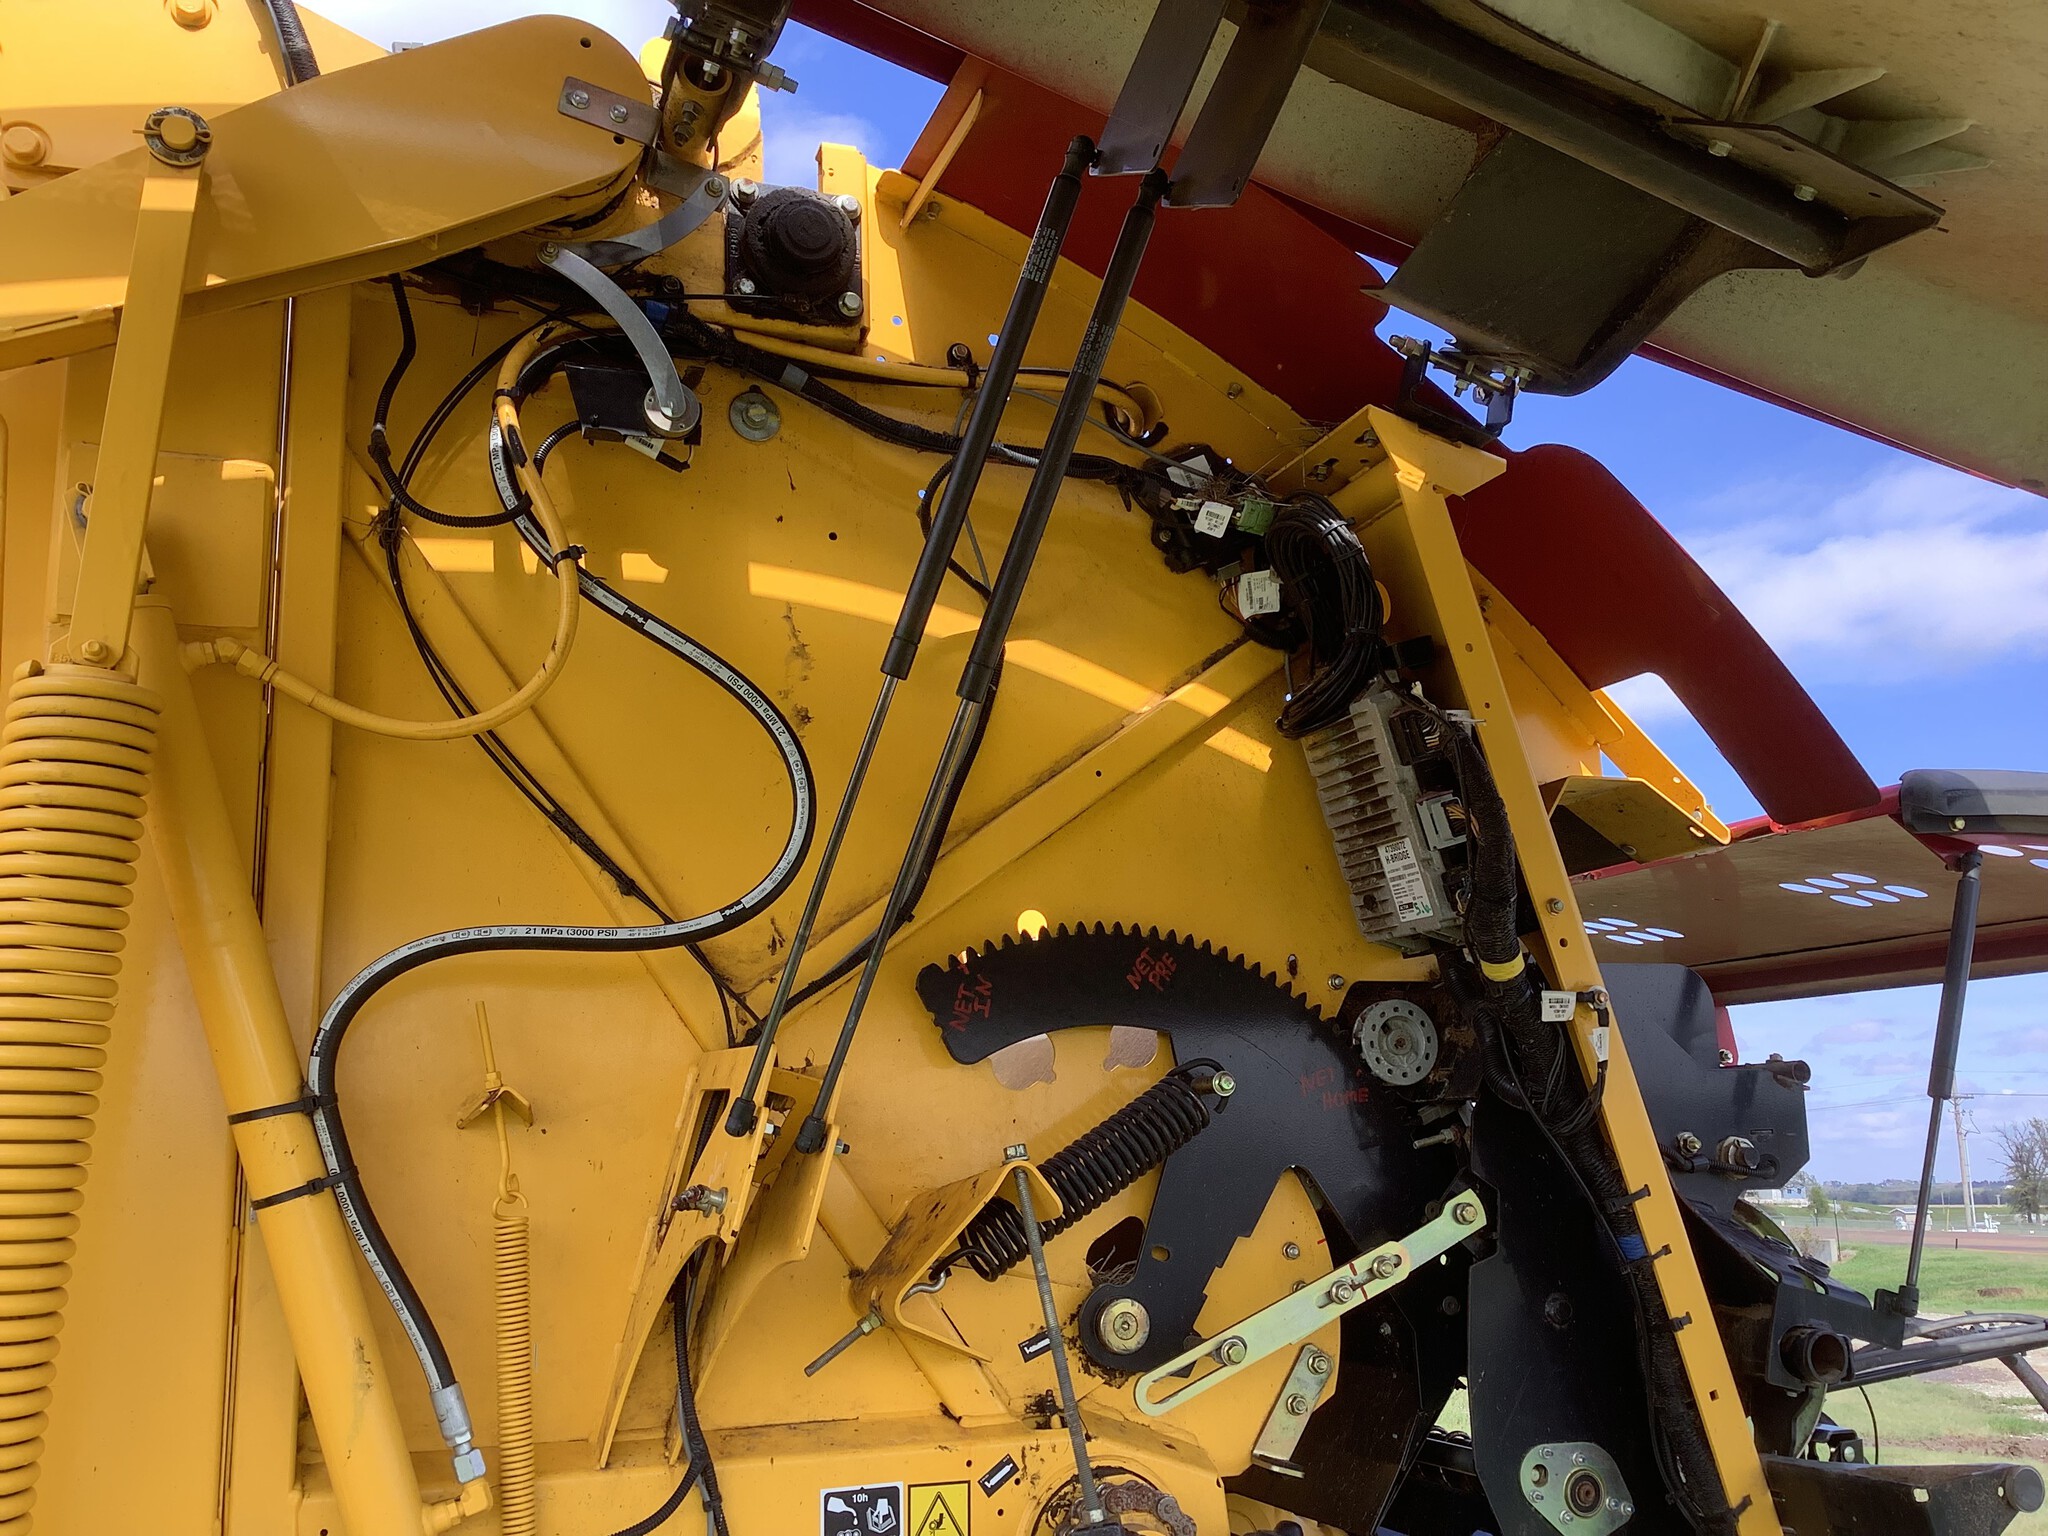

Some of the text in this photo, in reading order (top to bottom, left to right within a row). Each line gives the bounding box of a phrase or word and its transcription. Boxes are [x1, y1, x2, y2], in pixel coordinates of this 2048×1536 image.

[726, 674, 786, 737] 21 MPa (3000 PSI)
[525, 927, 618, 938] 21 MPa (3000 PSI)
[1126, 947, 1155, 990] NET
[1149, 952, 1177, 992] PRE
[950, 983, 975, 1032] NET
[973, 973, 993, 1018] IN
[338, 1191, 356, 1220] (3000
[351, 1220, 366, 1241] MPa
[361, 1243, 372, 1255] 21
[852, 1493, 869, 1503] 10h
